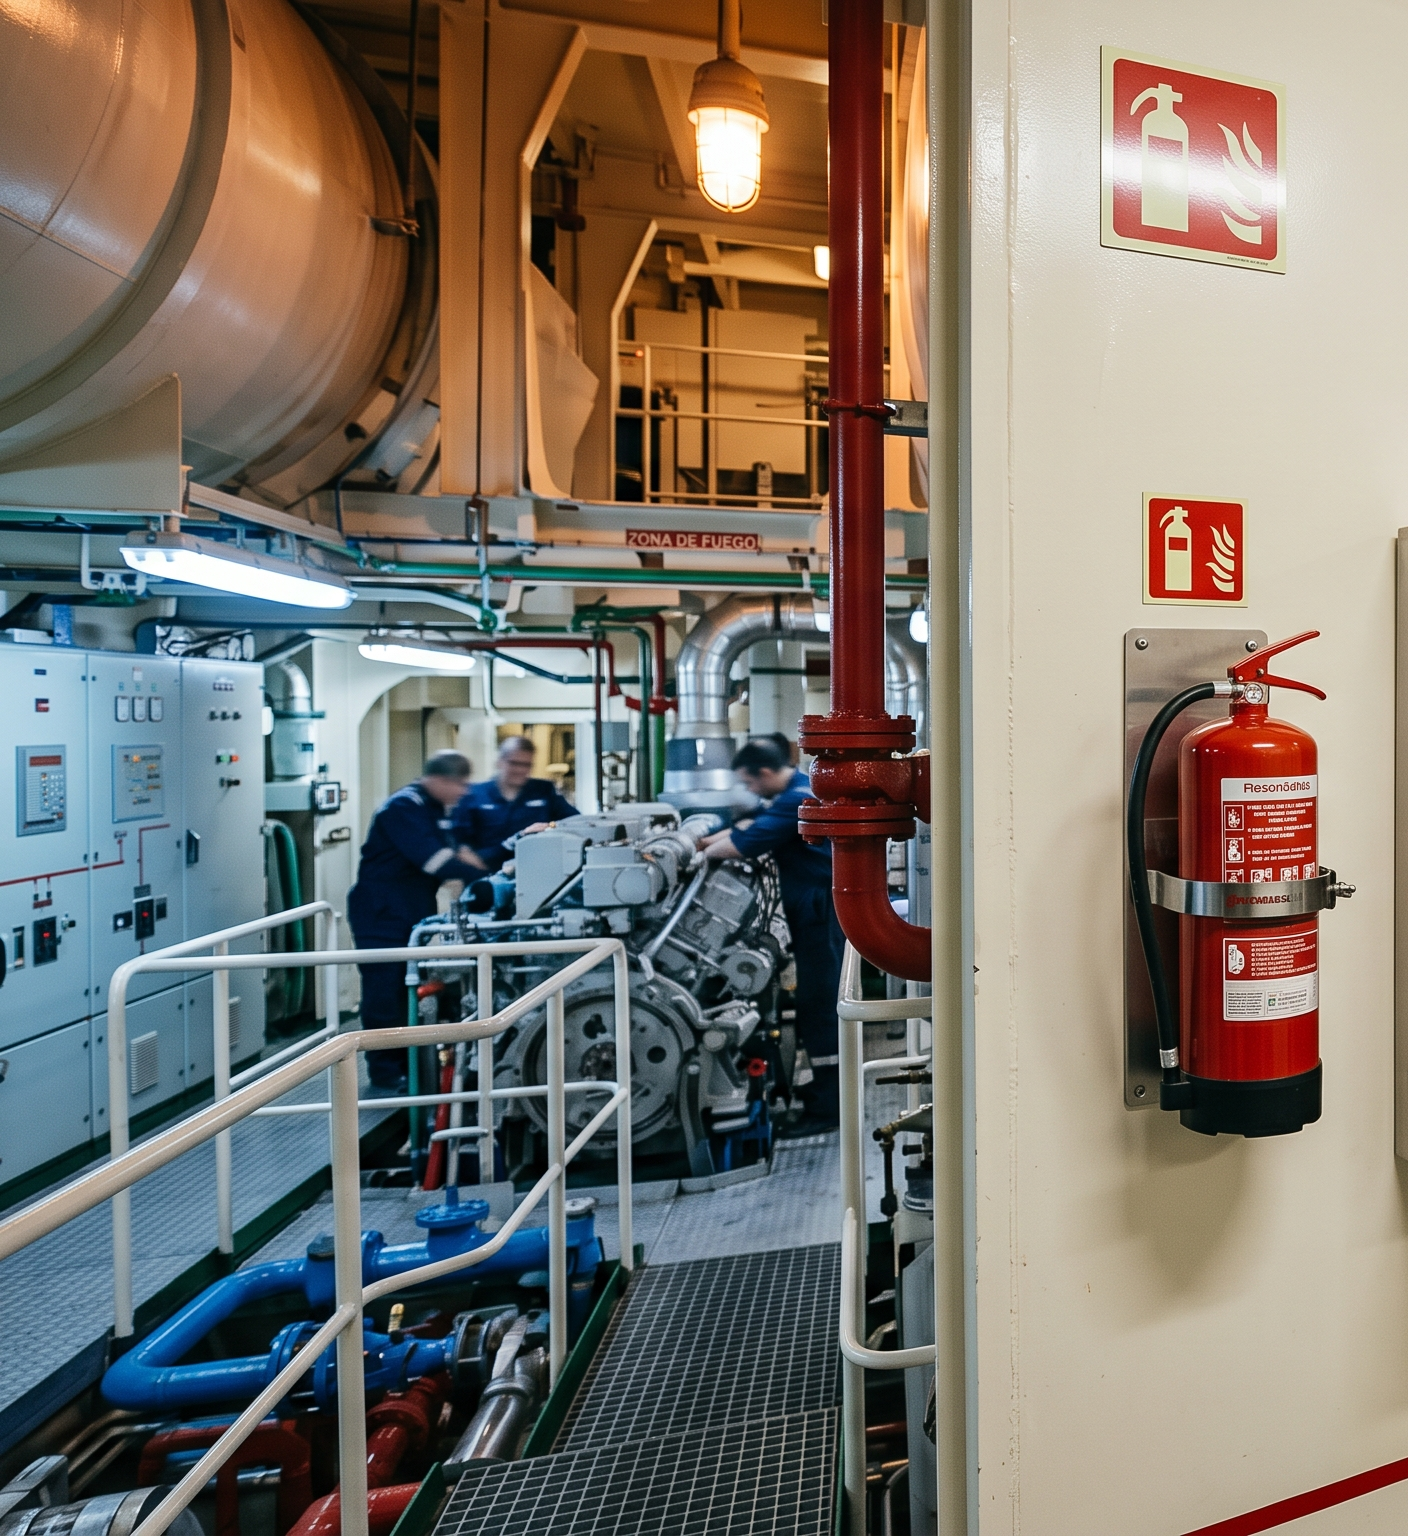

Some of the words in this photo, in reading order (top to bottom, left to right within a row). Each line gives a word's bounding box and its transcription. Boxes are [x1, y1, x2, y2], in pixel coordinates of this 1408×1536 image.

[628, 532, 673, 547] ZONA
[676, 533, 698, 547] DE
[701, 534, 756, 549] FUEGO
